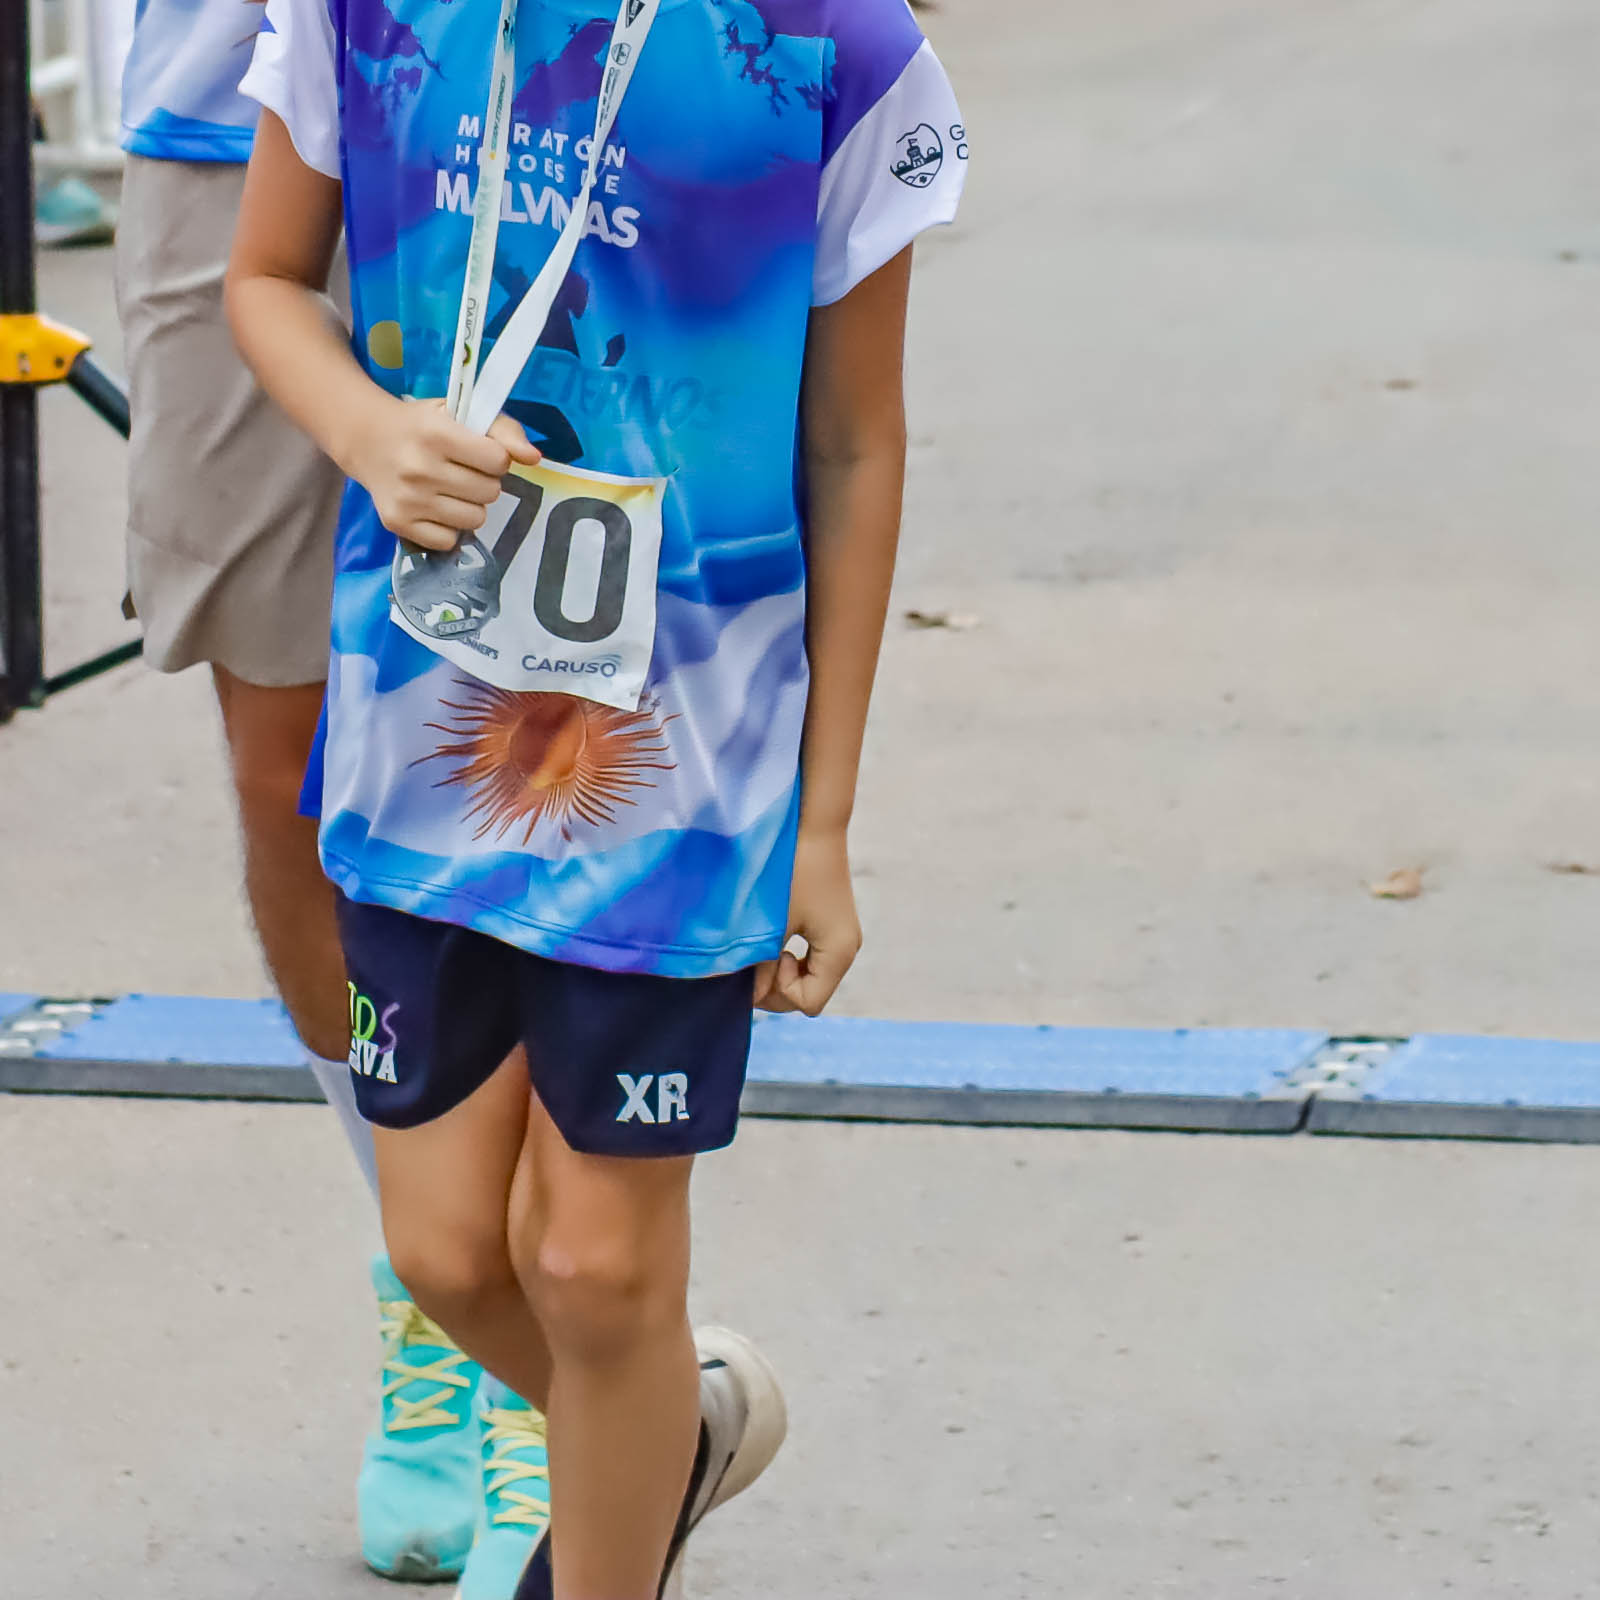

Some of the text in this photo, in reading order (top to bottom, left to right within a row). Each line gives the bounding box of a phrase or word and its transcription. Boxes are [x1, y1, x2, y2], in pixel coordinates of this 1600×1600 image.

[458, 114, 626, 169] MRATÓN
[435, 168, 640, 248] MLVINAS
[491, 472, 632, 643] 70
[521, 654, 618, 678] CARUSO
[615, 1071, 691, 1126] XR
